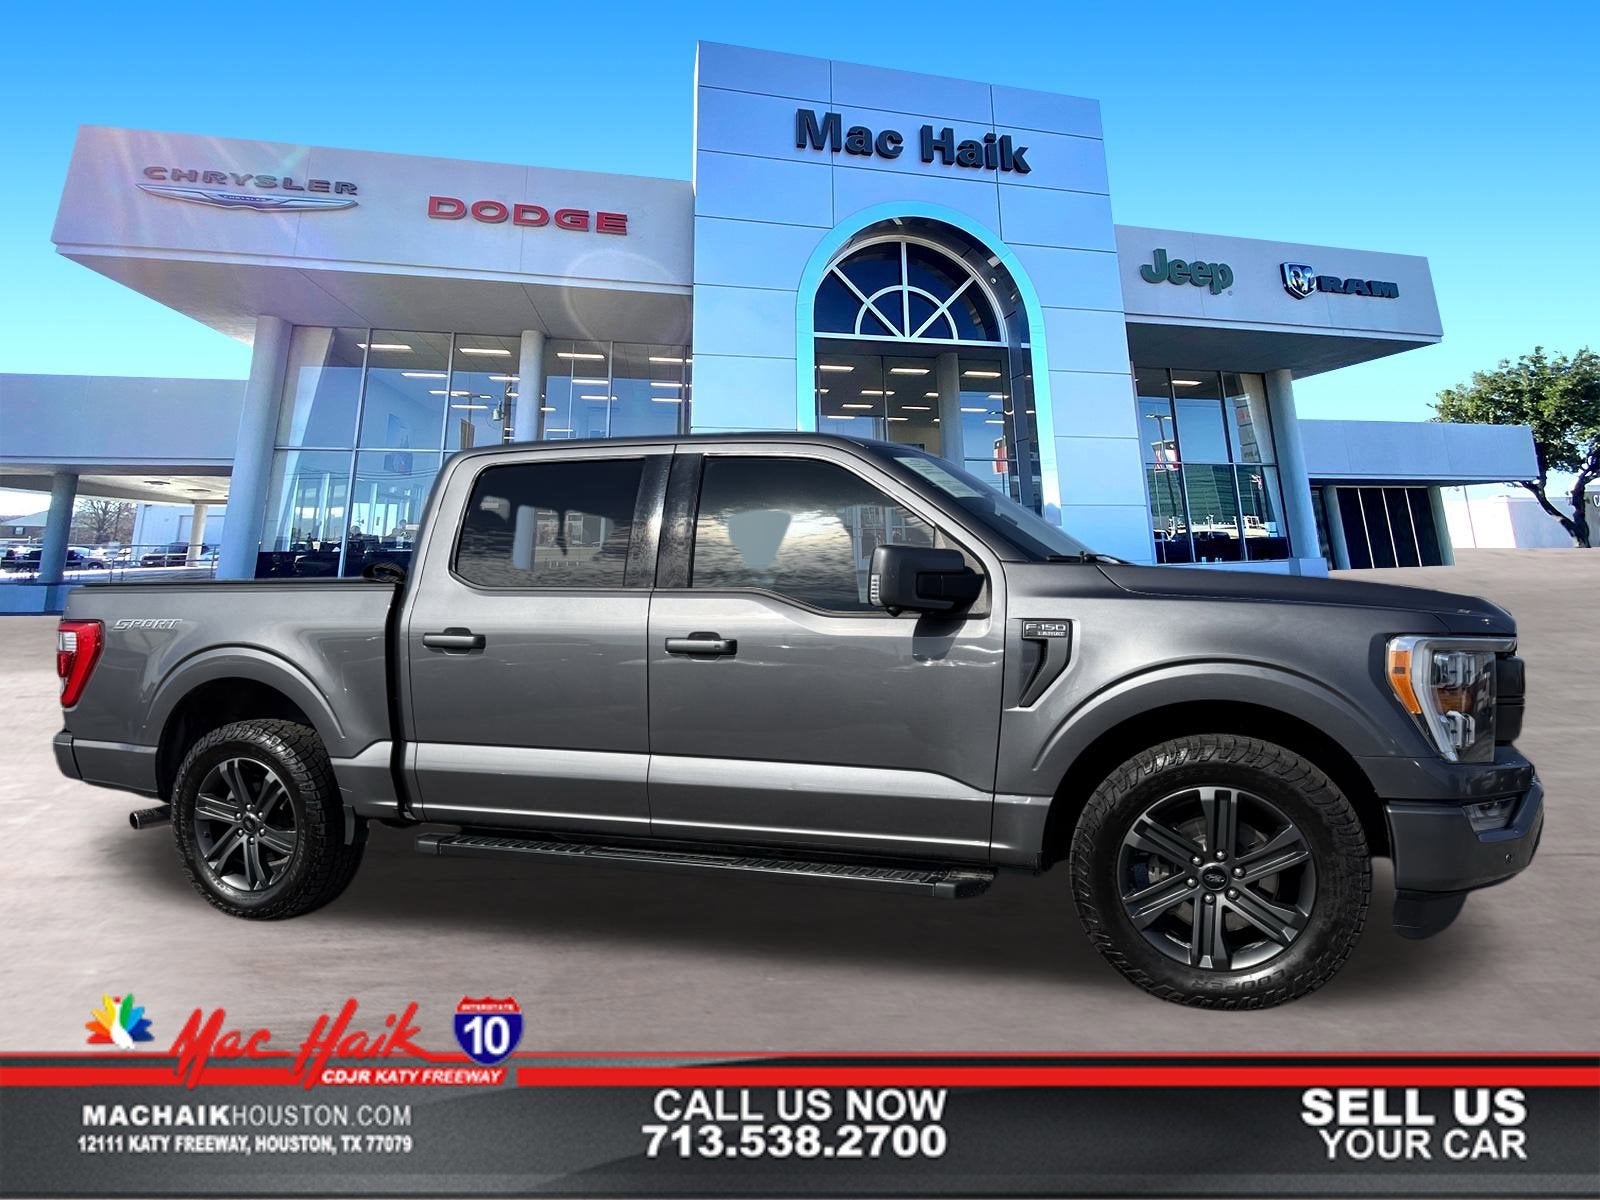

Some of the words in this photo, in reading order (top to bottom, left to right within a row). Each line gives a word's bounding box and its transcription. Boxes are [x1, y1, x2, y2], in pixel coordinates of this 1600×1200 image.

[796, 107, 904, 160] Mac
[919, 124, 1031, 174] Haik
[143, 166, 358, 196] CHRYSLER
[428, 196, 628, 236] DODGE
[1140, 248, 1234, 295] Jeep
[1316, 275, 1400, 299] RAM
[112, 618, 183, 631] SPORT
